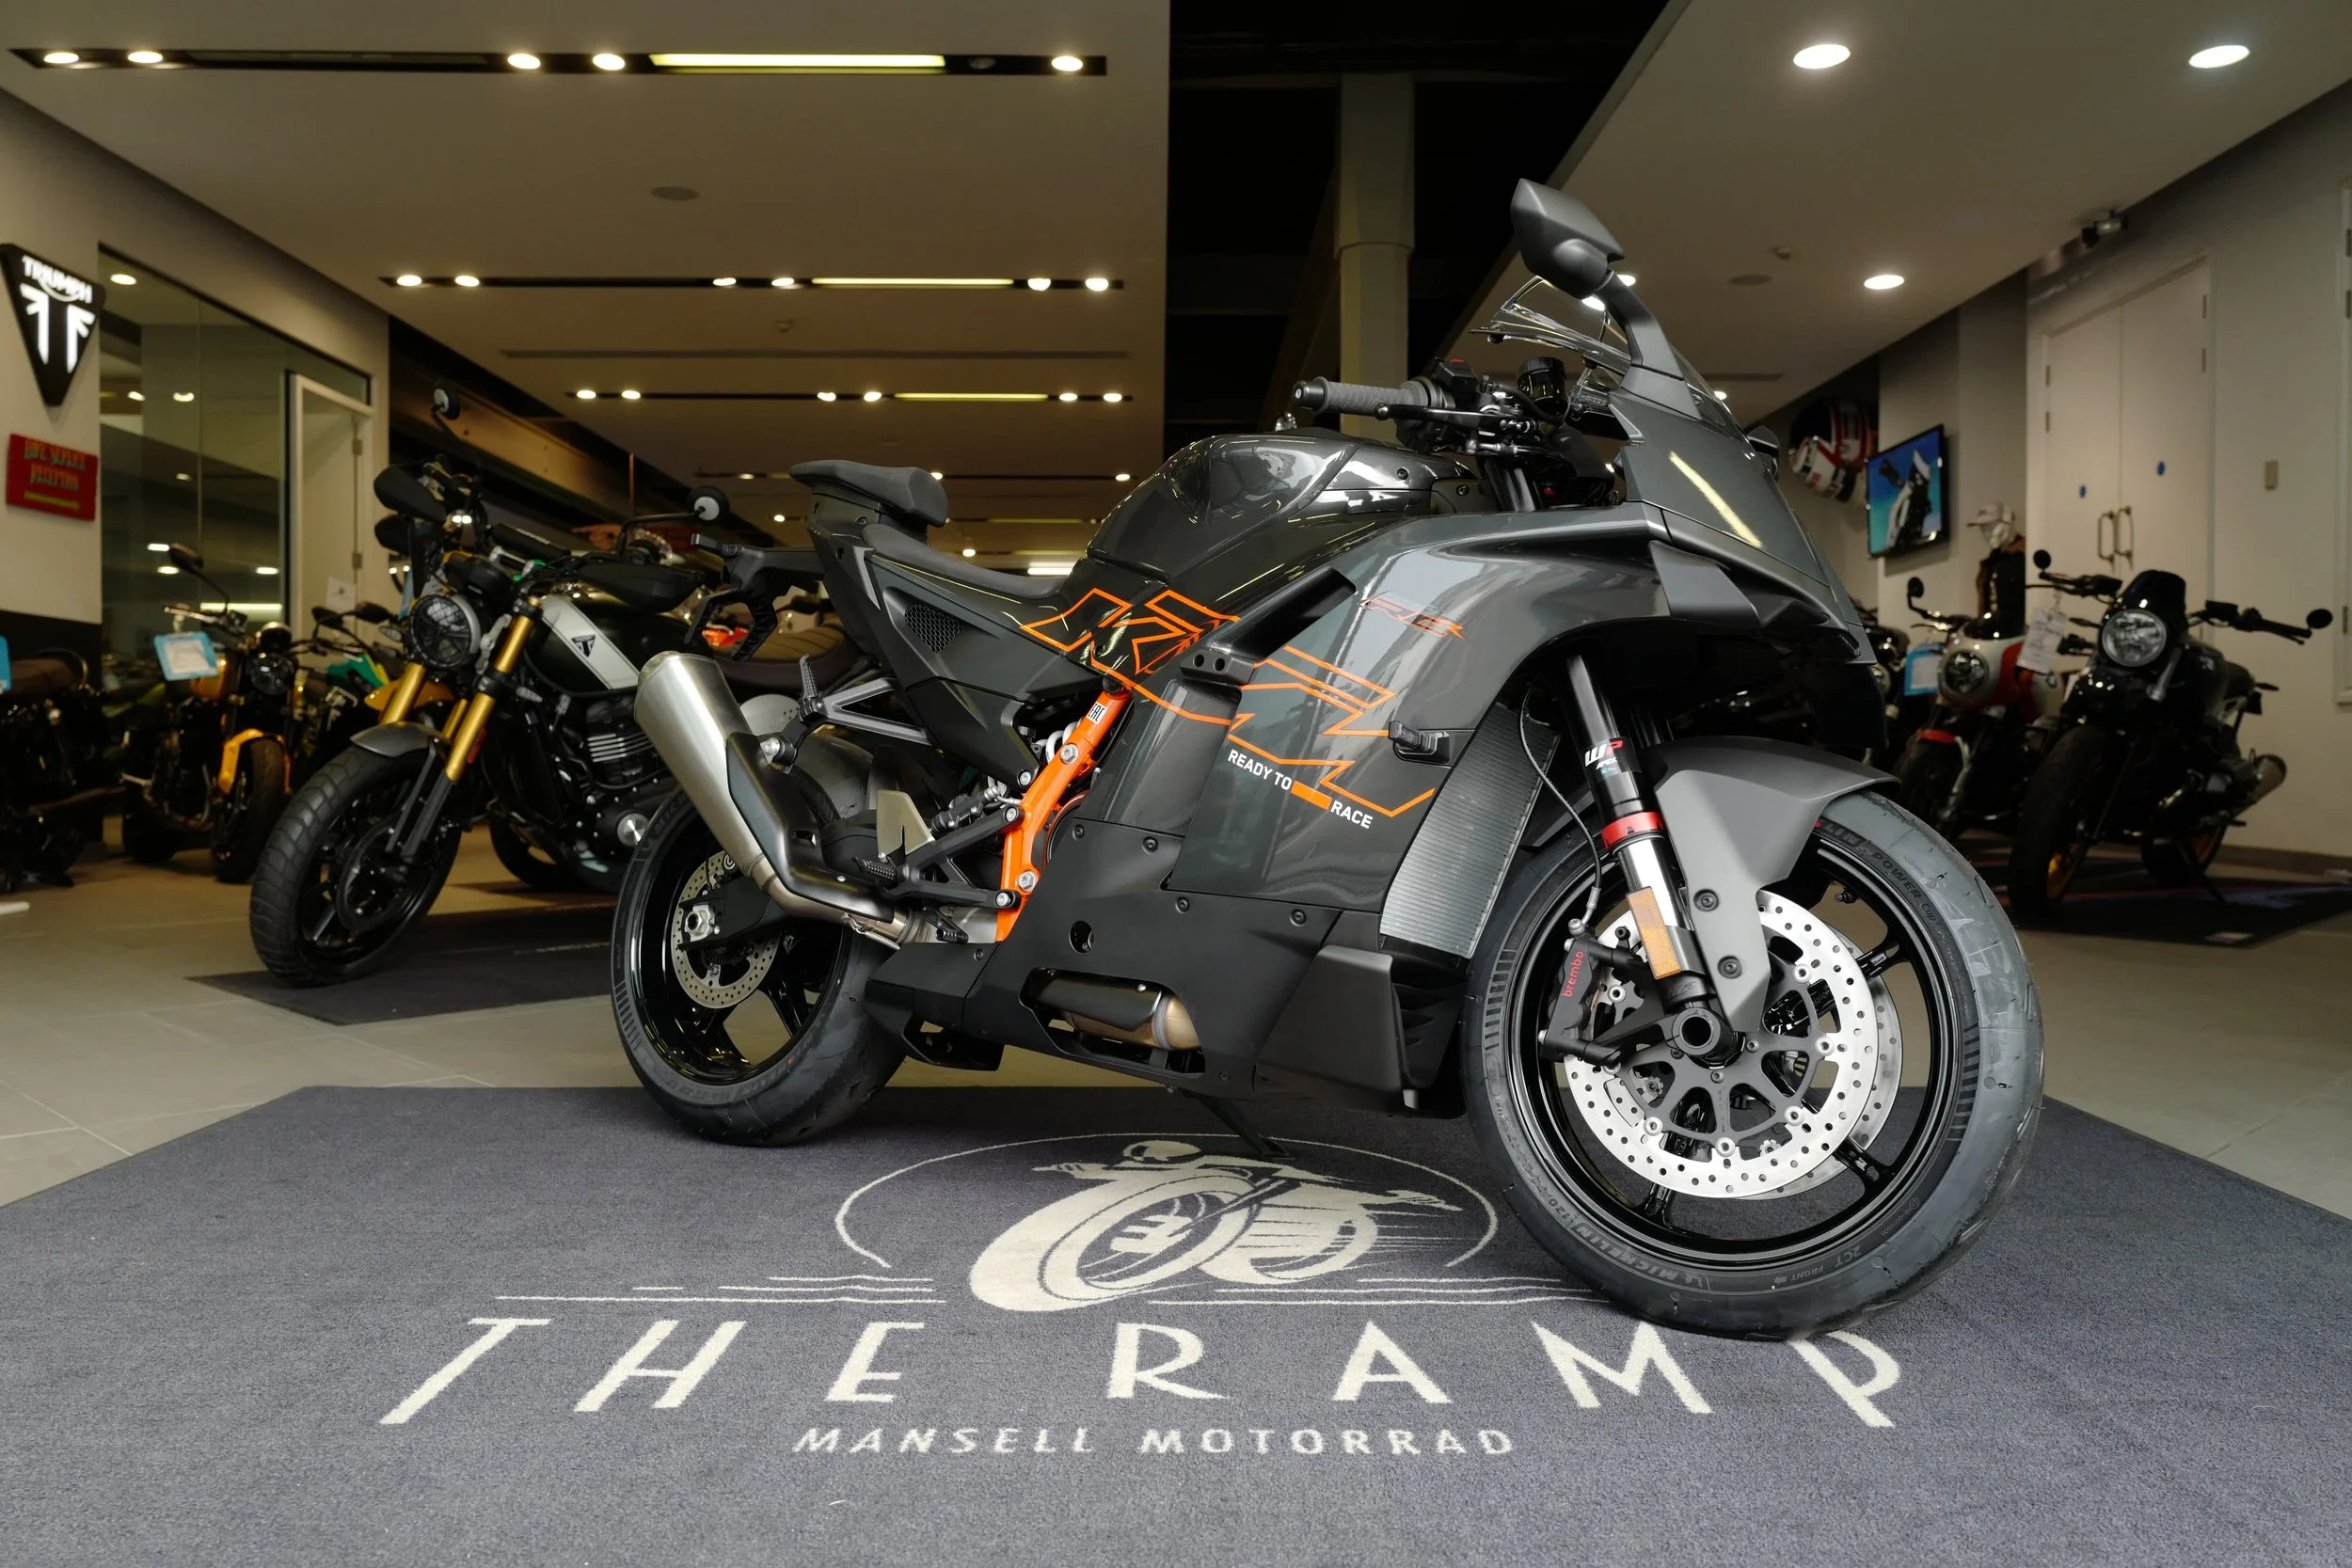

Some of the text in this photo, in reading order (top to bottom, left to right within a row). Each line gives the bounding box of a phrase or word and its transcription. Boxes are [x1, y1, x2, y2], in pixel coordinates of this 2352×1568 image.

[22, 255, 92, 304] TRIUMPH
[1584, 740, 1625, 768] WP
[1228, 750, 1374, 830] READY TO RACE
[1872, 851, 1922, 899] POWER
[1562, 950, 1584, 998] brembo
[1575, 1225, 1677, 1282] MICHELIN
[1790, 1244, 1862, 1281] 2CT FRONT
[379, 1317, 1901, 1429] THE RAMP
[792, 1426, 1514, 1457] MANSELL MOTORRAD
